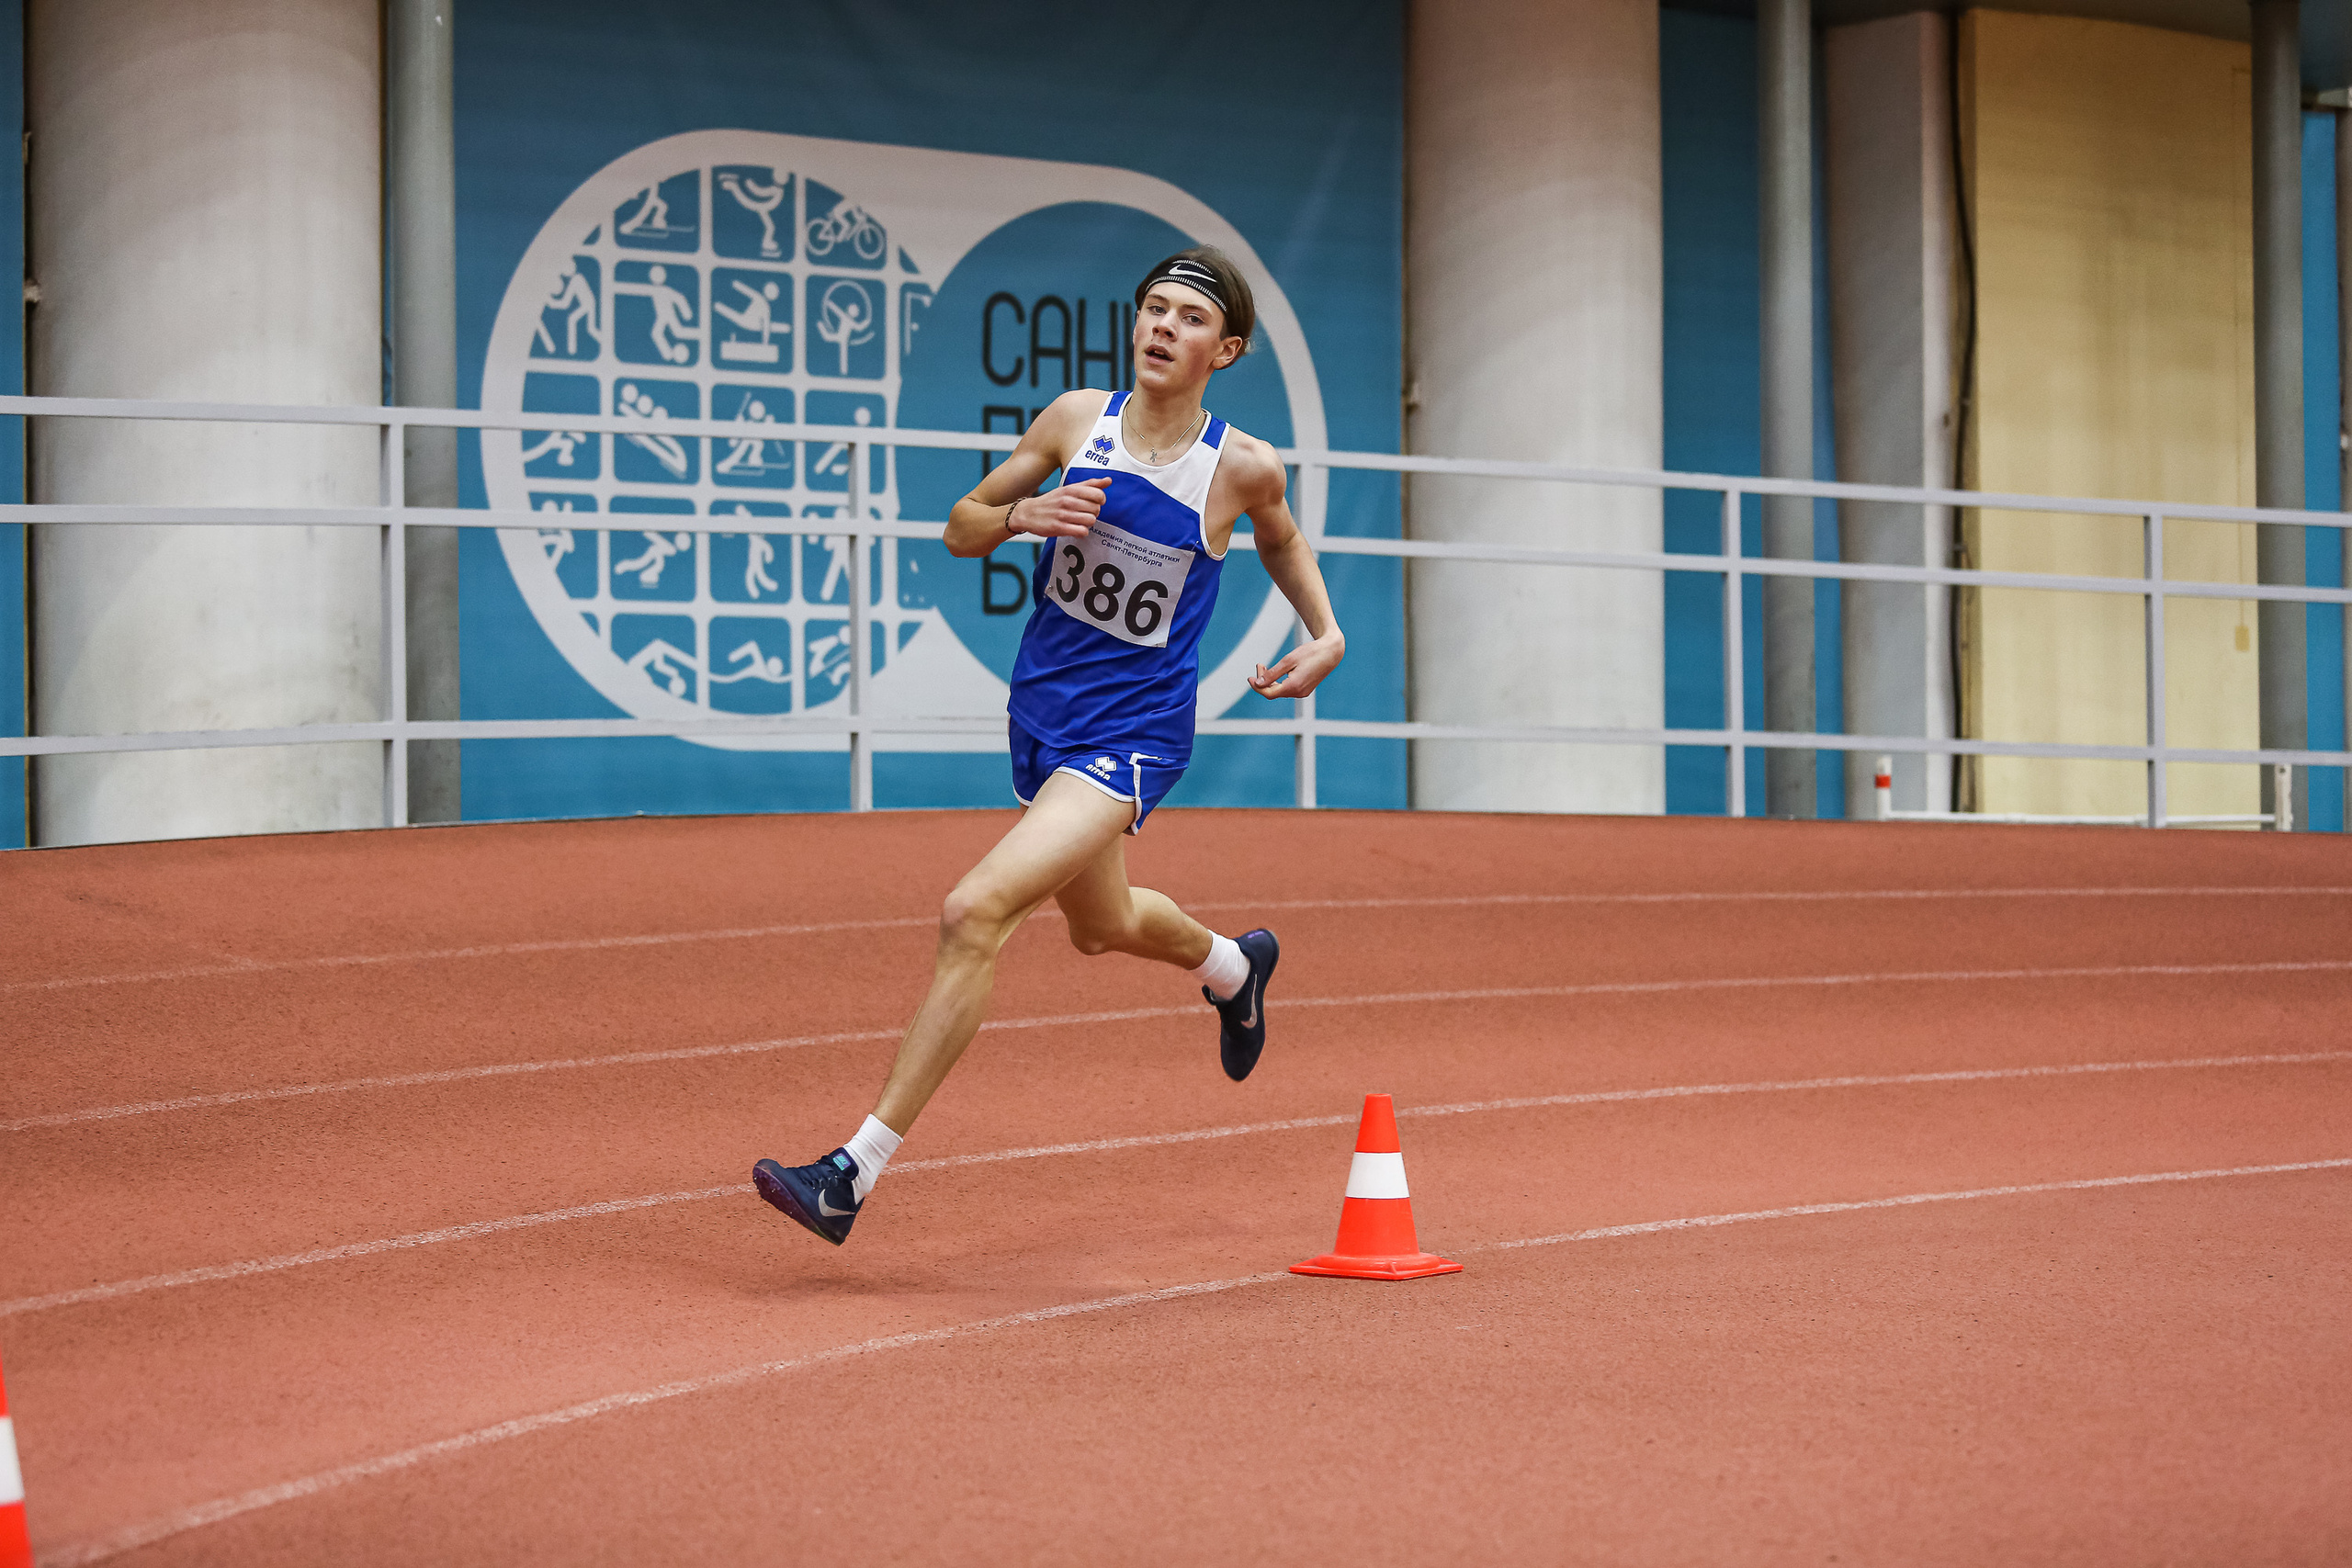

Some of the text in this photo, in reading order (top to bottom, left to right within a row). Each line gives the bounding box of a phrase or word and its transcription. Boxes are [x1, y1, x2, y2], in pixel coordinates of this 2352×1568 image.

[1084, 449, 1110, 467] errea
[1089, 525, 1181, 563] Академия легкой атлетики
[1101, 539, 1163, 568] Санкт-Петербурга
[1057, 544, 1169, 637] 386
